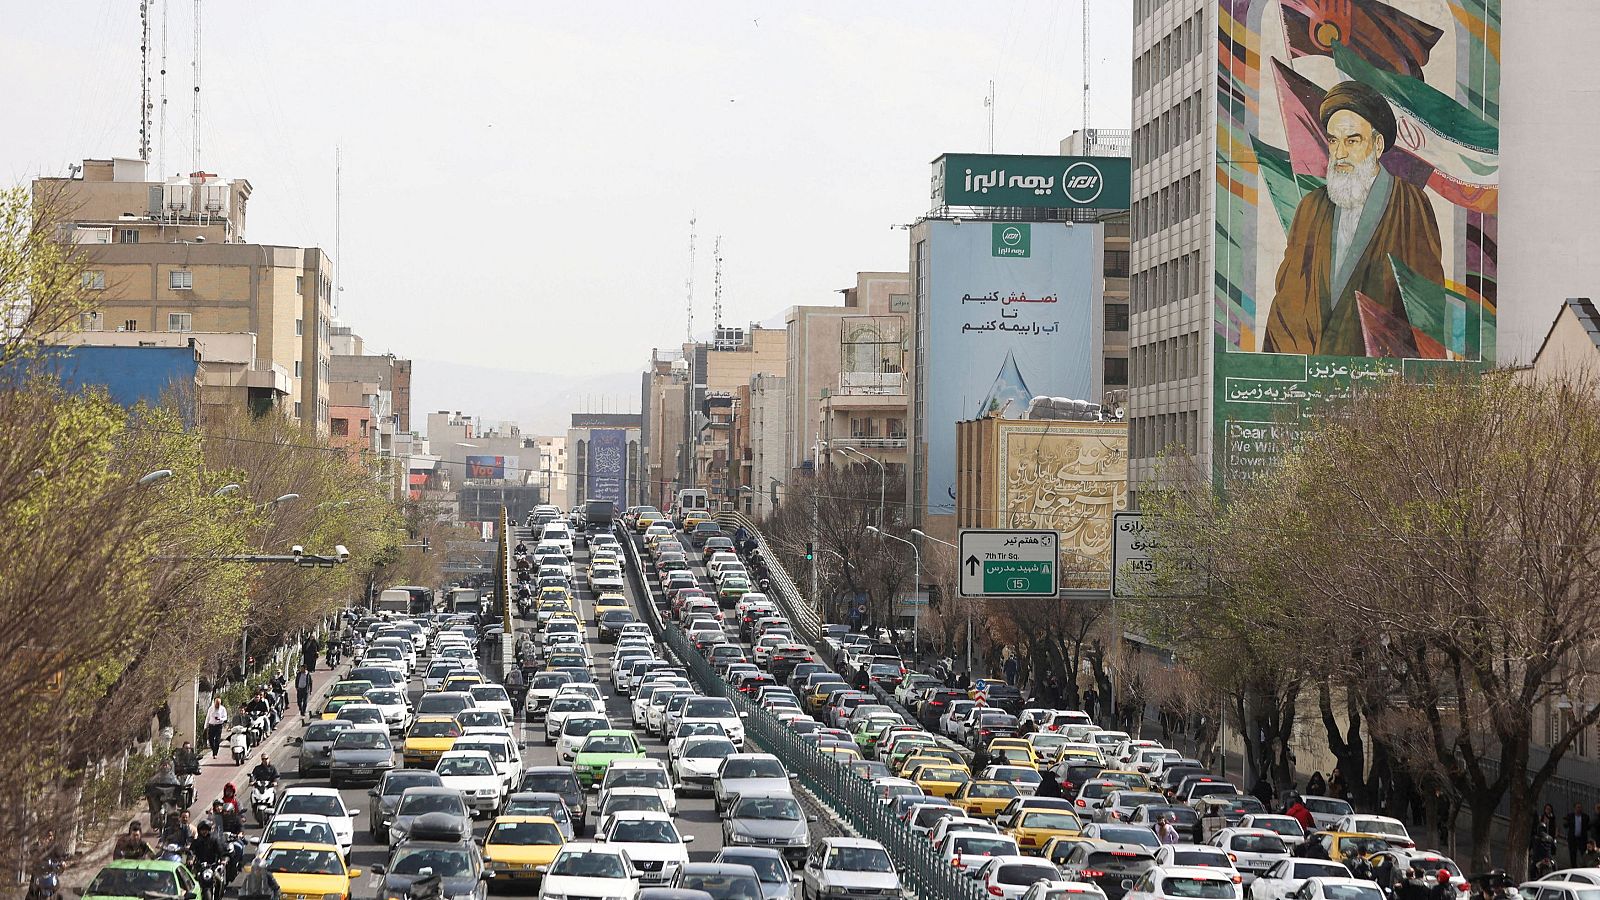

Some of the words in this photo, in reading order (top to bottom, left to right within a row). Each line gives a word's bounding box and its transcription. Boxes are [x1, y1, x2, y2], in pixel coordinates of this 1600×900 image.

[965, 168, 1005, 193] البرز
[1009, 176, 1054, 195] بیمه
[998, 247, 1010, 255] البرز
[962, 291, 999, 305] کنیم
[1001, 291, 1057, 305] نصفش
[1001, 308, 1018, 318] تا
[962, 320, 997, 334] کنیم
[999, 321, 1030, 335] بیمه
[1032, 322, 1040, 335] را
[1042, 321, 1059, 335] آب
[1231, 383, 1263, 399] زمین
[1264, 386, 1279, 400] به
[1230, 424, 1267, 439] Dear
[1003, 536, 1018, 546] تیر
[1018, 536, 1039, 548] هفتم
[1008, 553, 1020, 561] Sq.
[986, 565, 1016, 574] مدرس
[1017, 563, 1039, 573] شهید
[1012, 579, 1023, 589] 15
